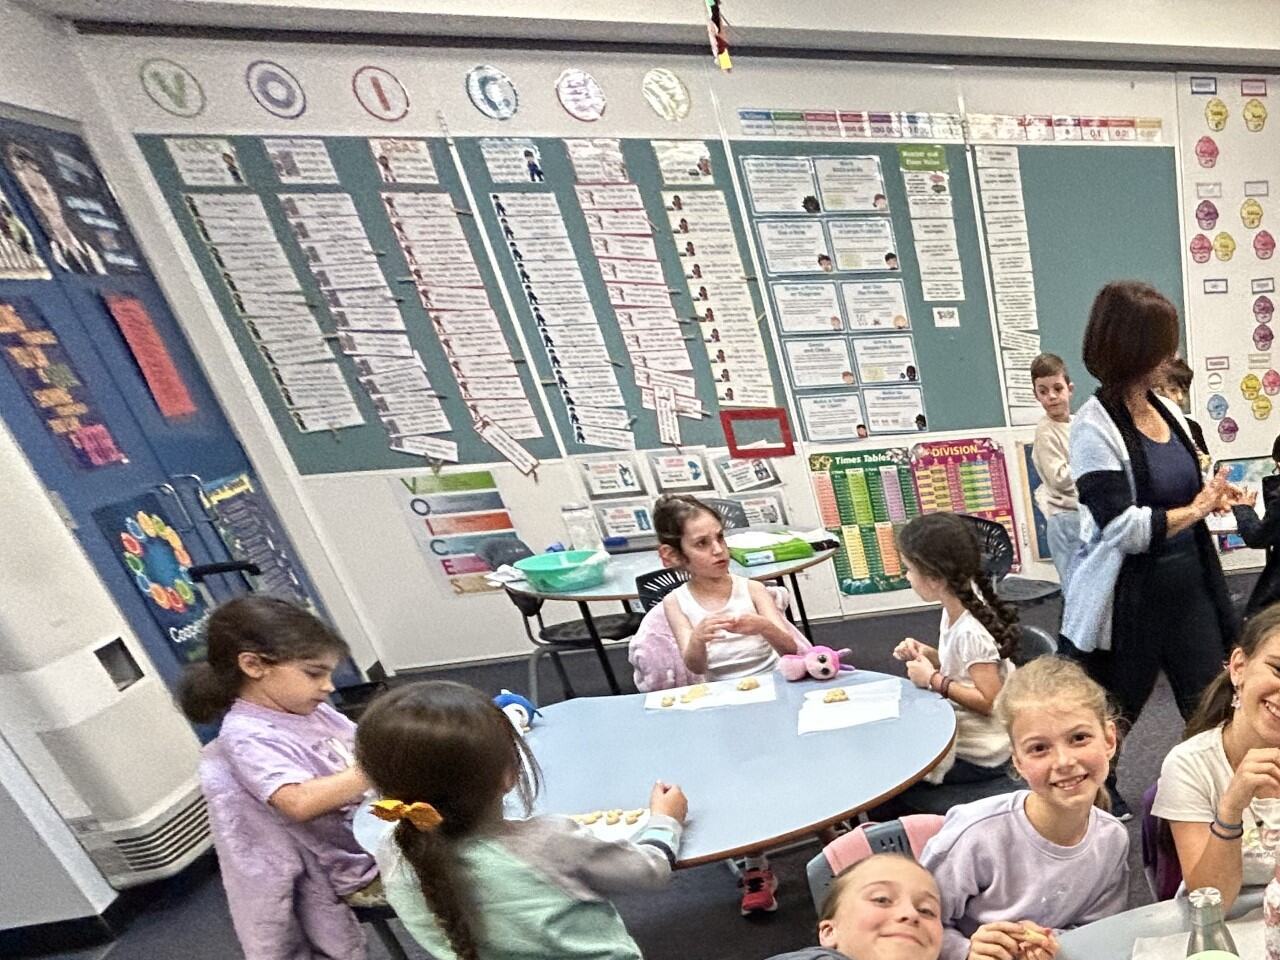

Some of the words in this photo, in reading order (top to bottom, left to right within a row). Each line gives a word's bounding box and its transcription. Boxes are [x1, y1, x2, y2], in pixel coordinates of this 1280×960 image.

[256, 70, 297, 110] O
[835, 454, 861, 465] Times
[864, 453, 891, 463] Tables
[932, 444, 978, 457] DIVISION
[400, 476, 416, 495] V
[410, 498, 430, 516] O
[425, 519, 435, 536] I
[430, 539, 450, 556] C
[442, 559, 457, 575] E
